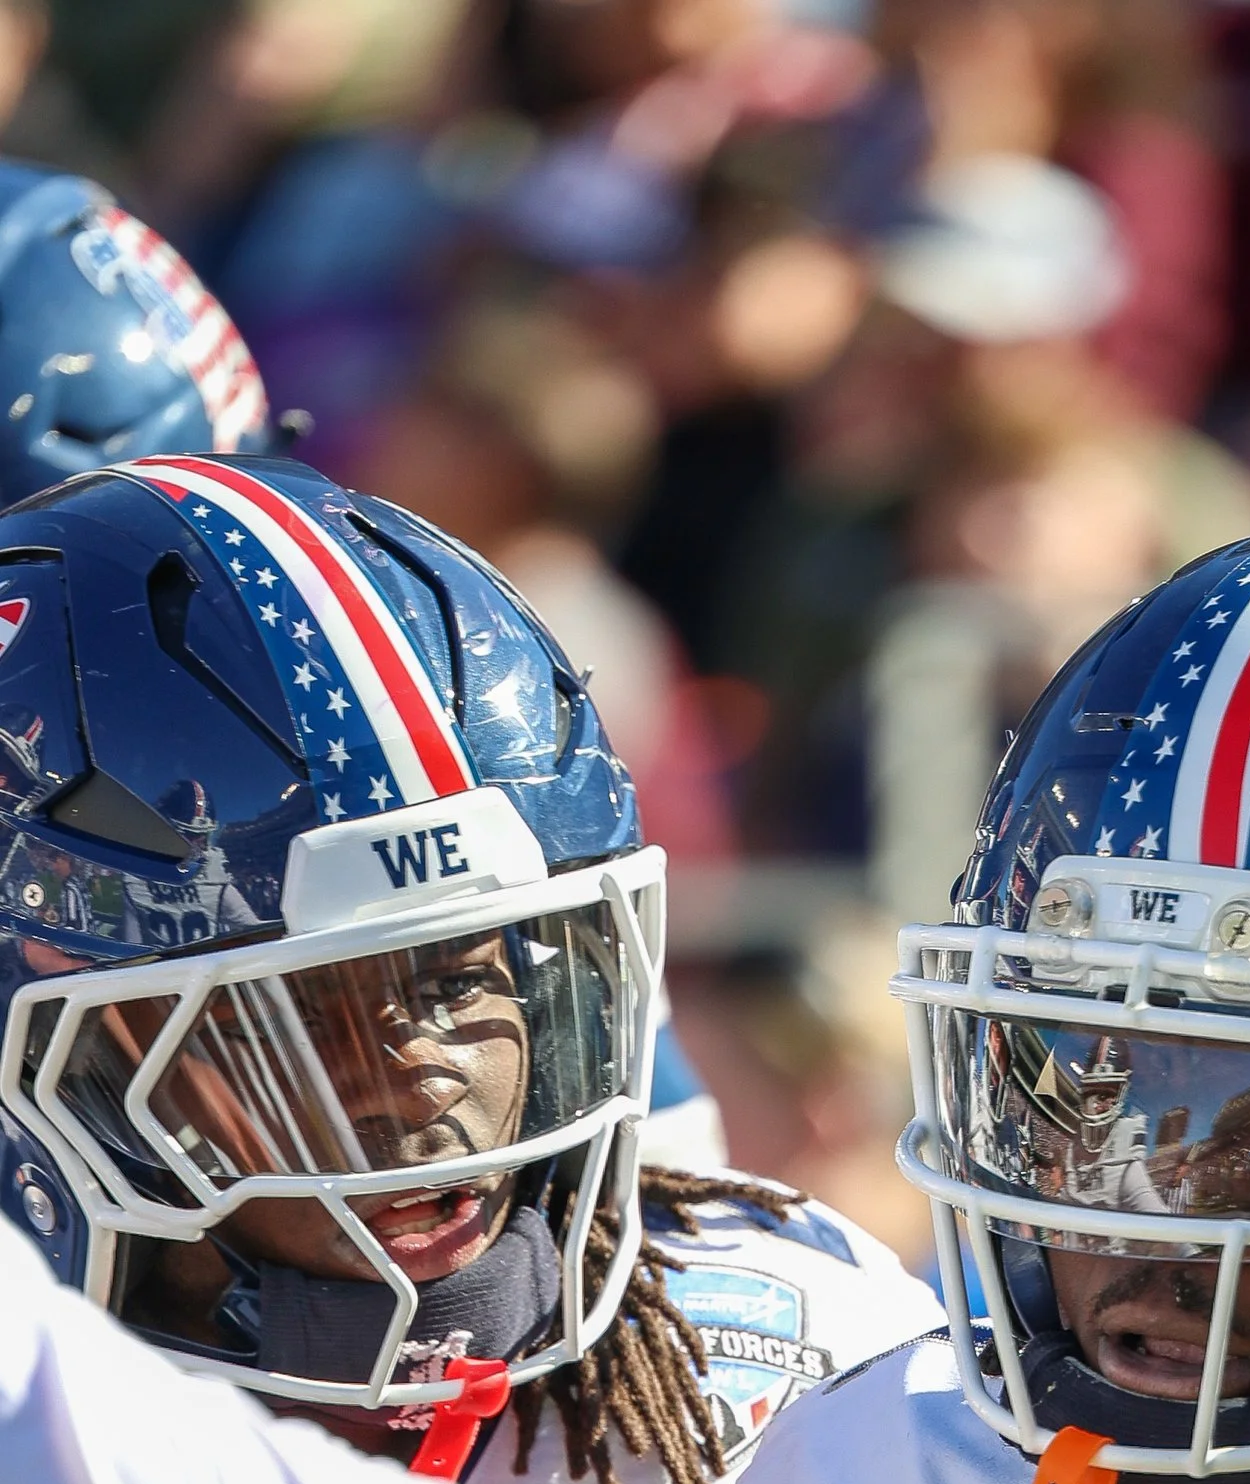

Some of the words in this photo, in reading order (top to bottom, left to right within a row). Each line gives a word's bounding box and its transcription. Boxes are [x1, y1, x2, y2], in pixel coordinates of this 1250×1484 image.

[370, 822, 470, 890] WE
[1128, 888, 1180, 925] WE
[699, 1327, 825, 1380] FORCES
